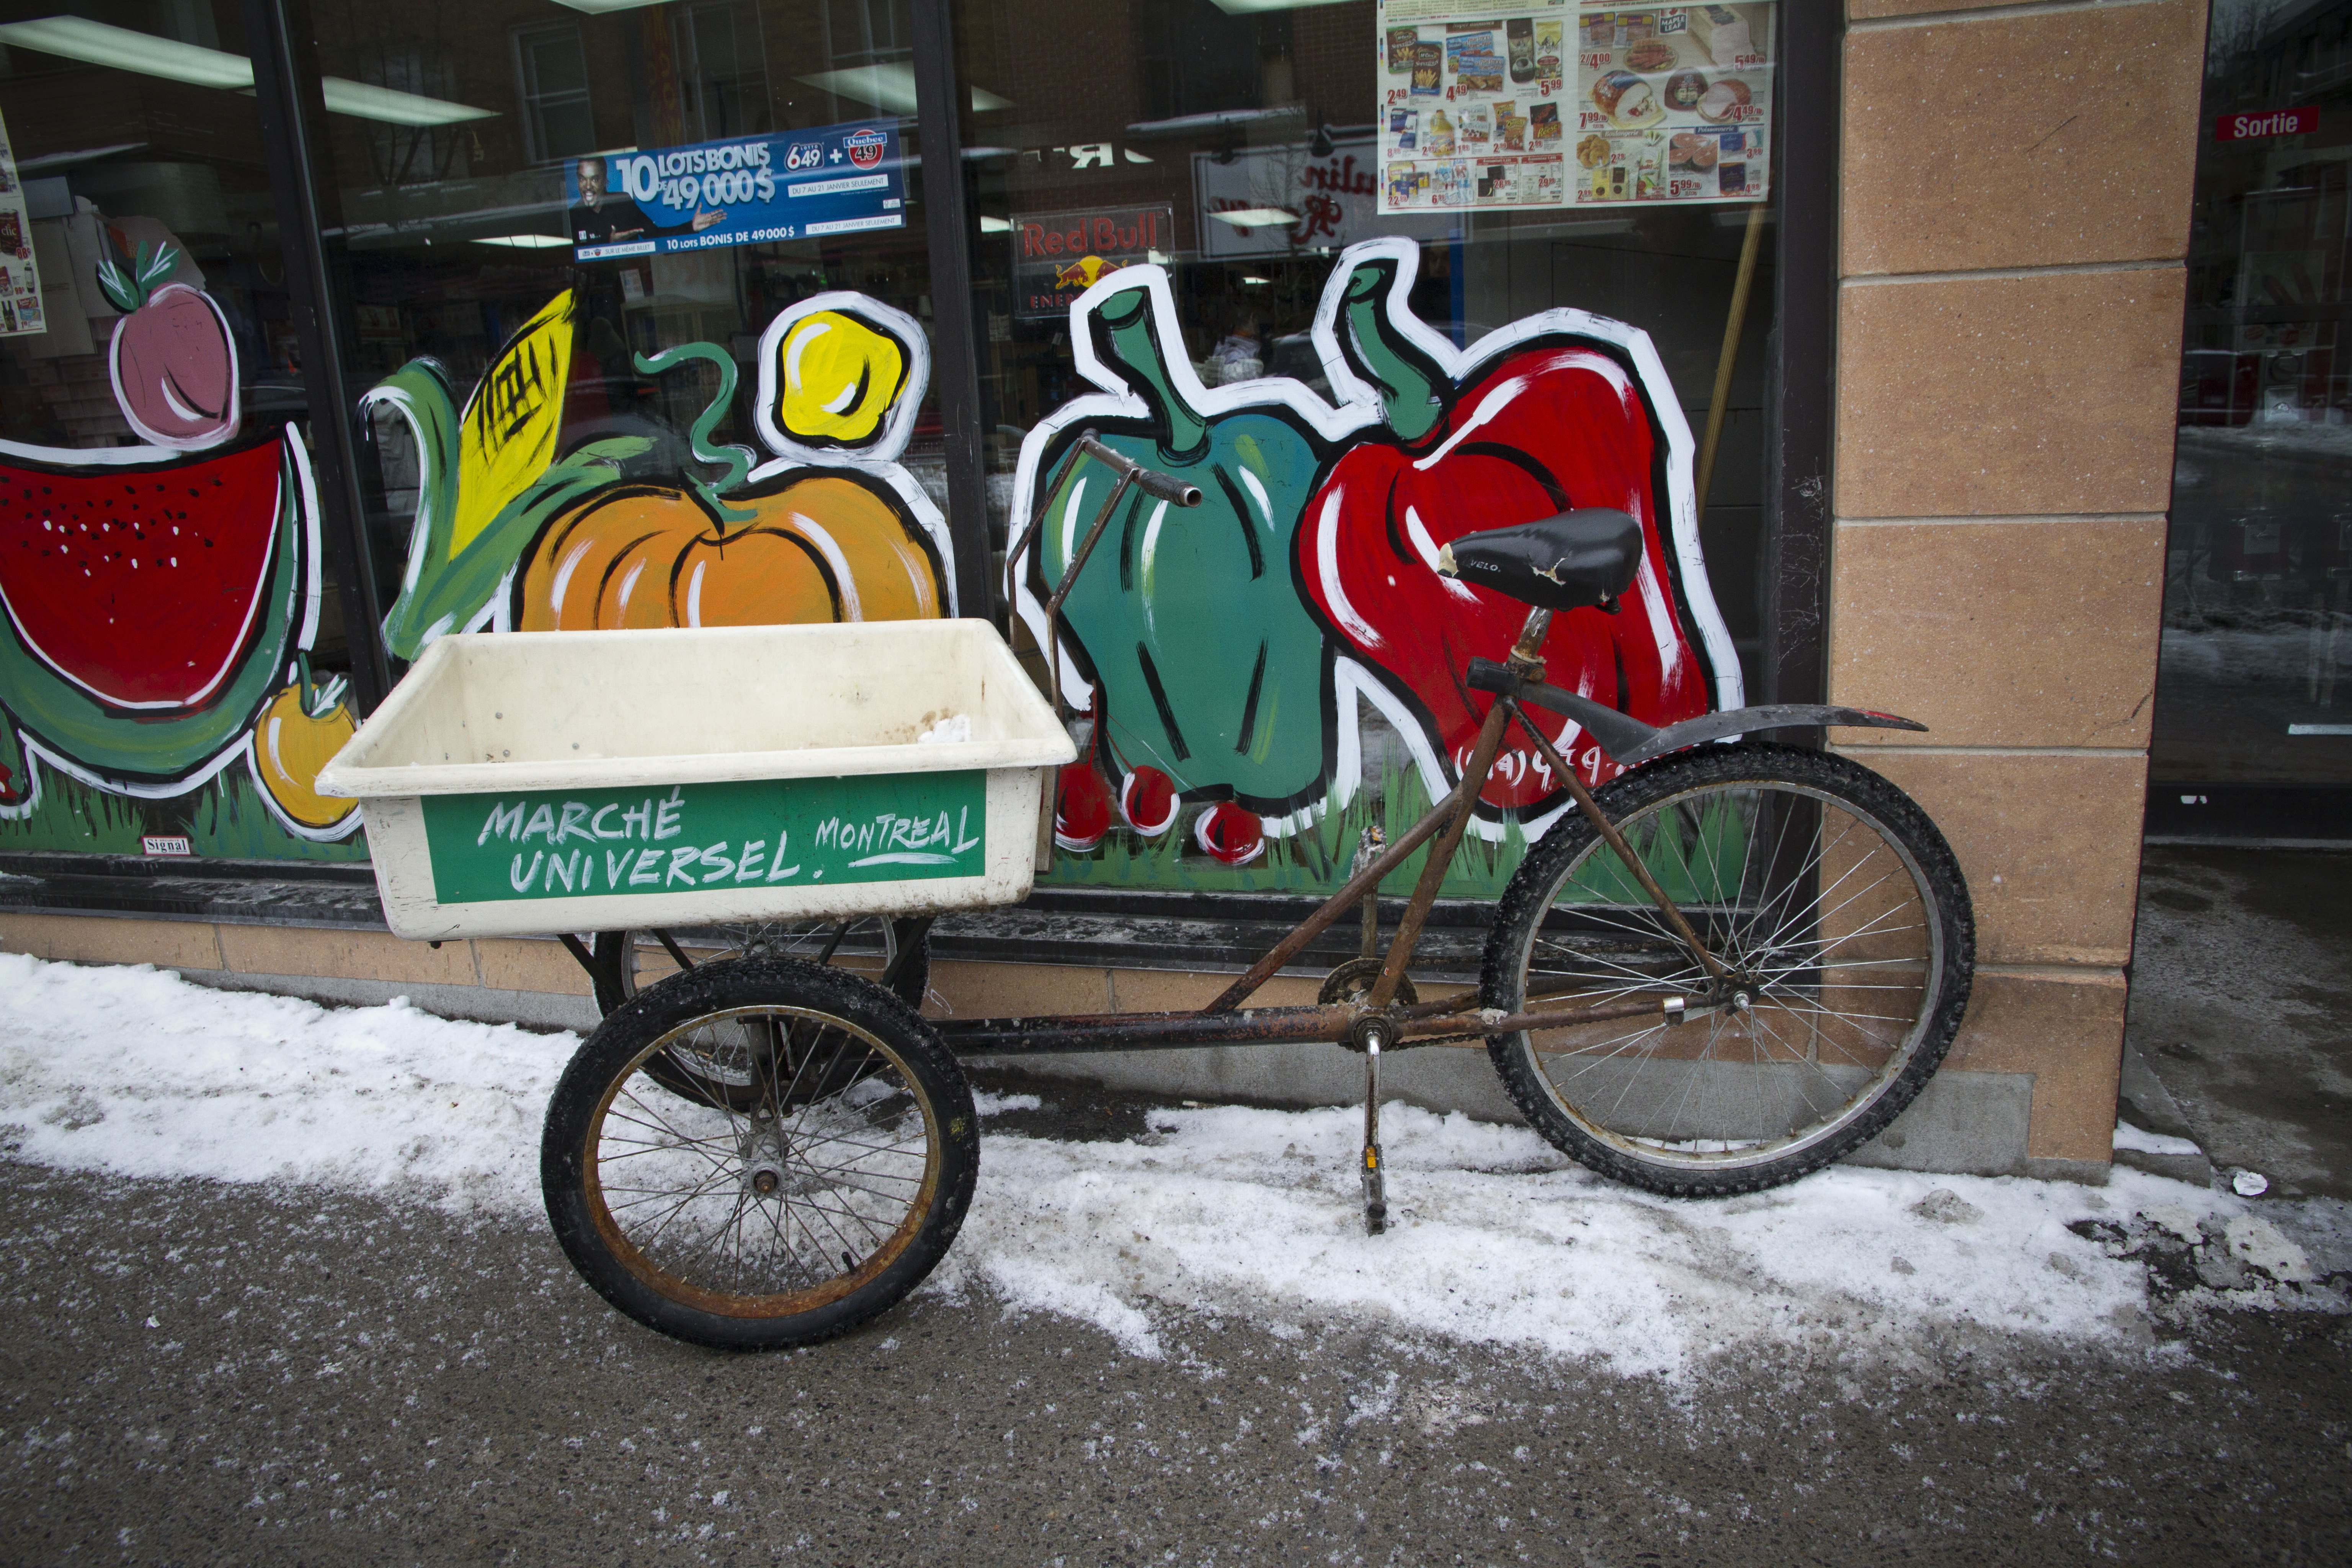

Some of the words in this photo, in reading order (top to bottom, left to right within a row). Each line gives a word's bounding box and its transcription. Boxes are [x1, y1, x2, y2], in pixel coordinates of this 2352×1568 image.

[1661, 15, 1685, 26] MAPLE
[1665, 22, 1681, 31] LEAF
[2233, 112, 2298, 139] Sortie
[787, 146, 821, 169] 649
[855, 144, 877, 161] 49
[616, 155, 659, 202] 10
[658, 150, 706, 177] LOTS
[705, 142, 771, 172] BONIS
[826, 182, 850, 190] JANVIER
[851, 178, 884, 187] SEULEMENT
[866, 217, 895, 226] SEULEMENT
[667, 239, 678, 250] 10
[680, 239, 698, 249] LOTS
[700, 232, 733, 247] BONIS
[735, 231, 749, 243] DE
[1023, 217, 1088, 256] Red
[1093, 212, 1157, 251] Bull
[477, 785, 686, 846] MARCHÉ
[815, 805, 980, 854] MONTREAL
[148, 839, 186, 853] Signal
